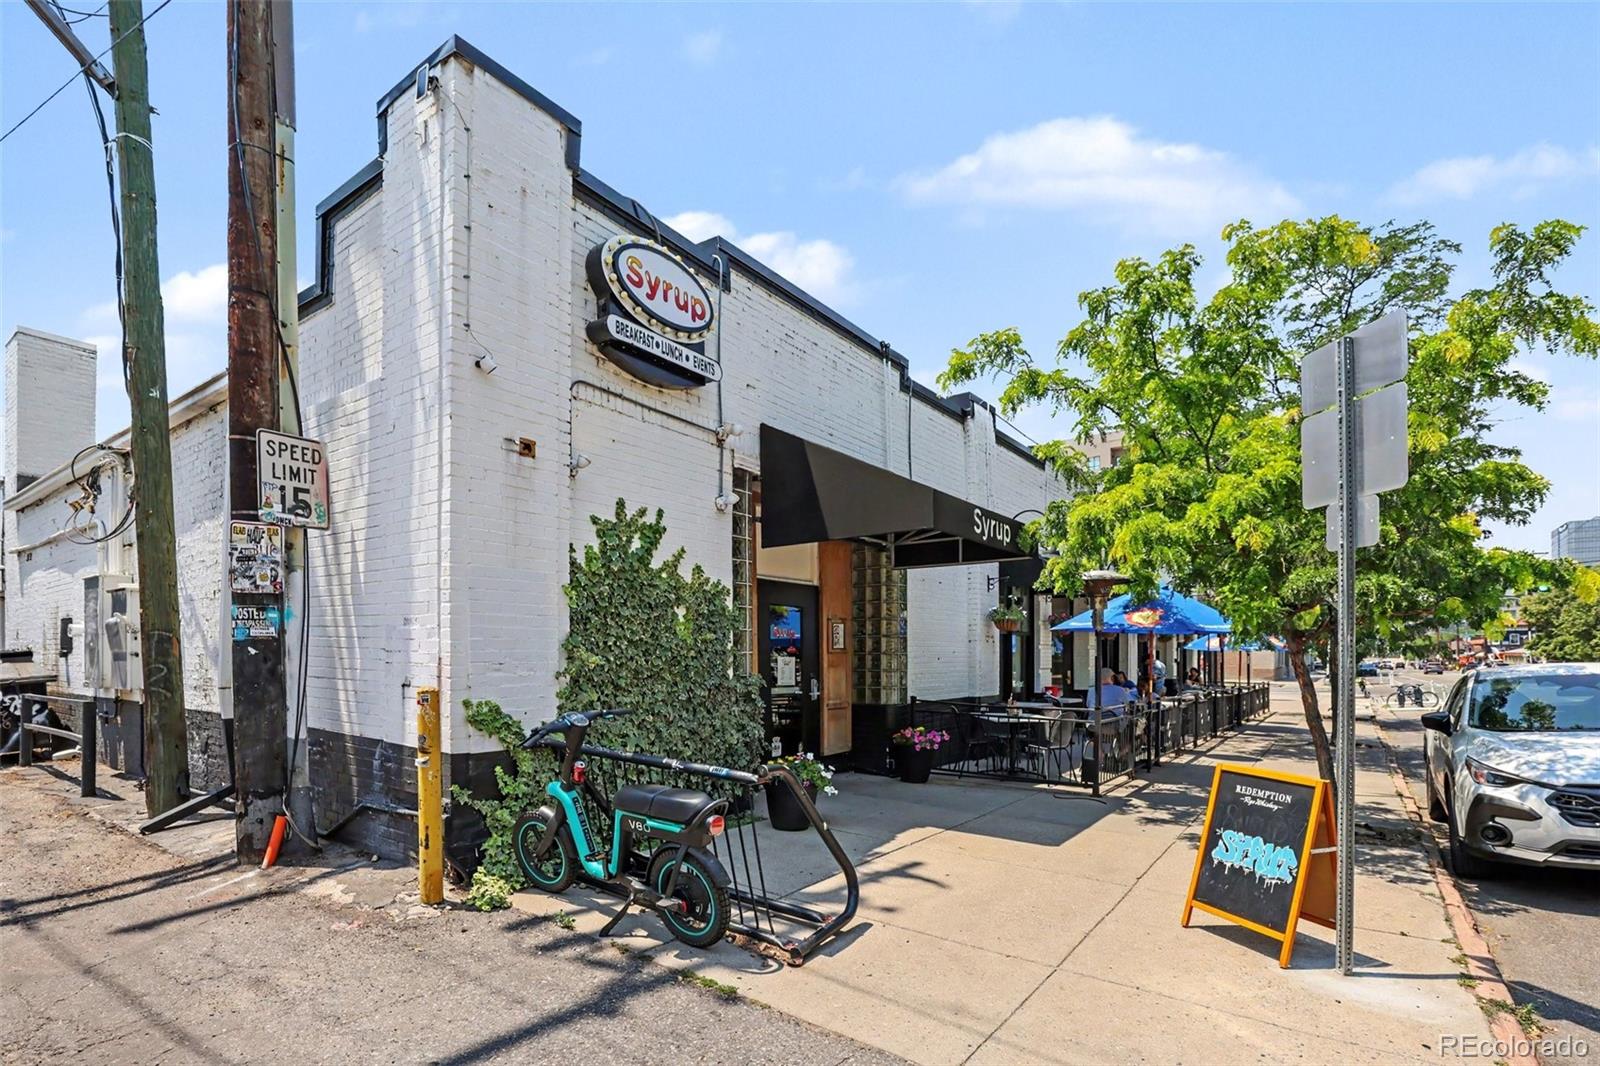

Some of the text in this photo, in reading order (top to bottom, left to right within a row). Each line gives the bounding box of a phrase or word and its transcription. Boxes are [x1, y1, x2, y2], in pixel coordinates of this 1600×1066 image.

[626, 255, 706, 322] Syrup
[615, 320, 716, 377] BREAKFAST LUNCH EVENTS
[266, 439, 322, 466] SPEED
[272, 462, 317, 485] LIMIT
[279, 484, 312, 519] 15
[973, 508, 1011, 547] Syrup
[1235, 784, 1292, 804] REDEMPTION
